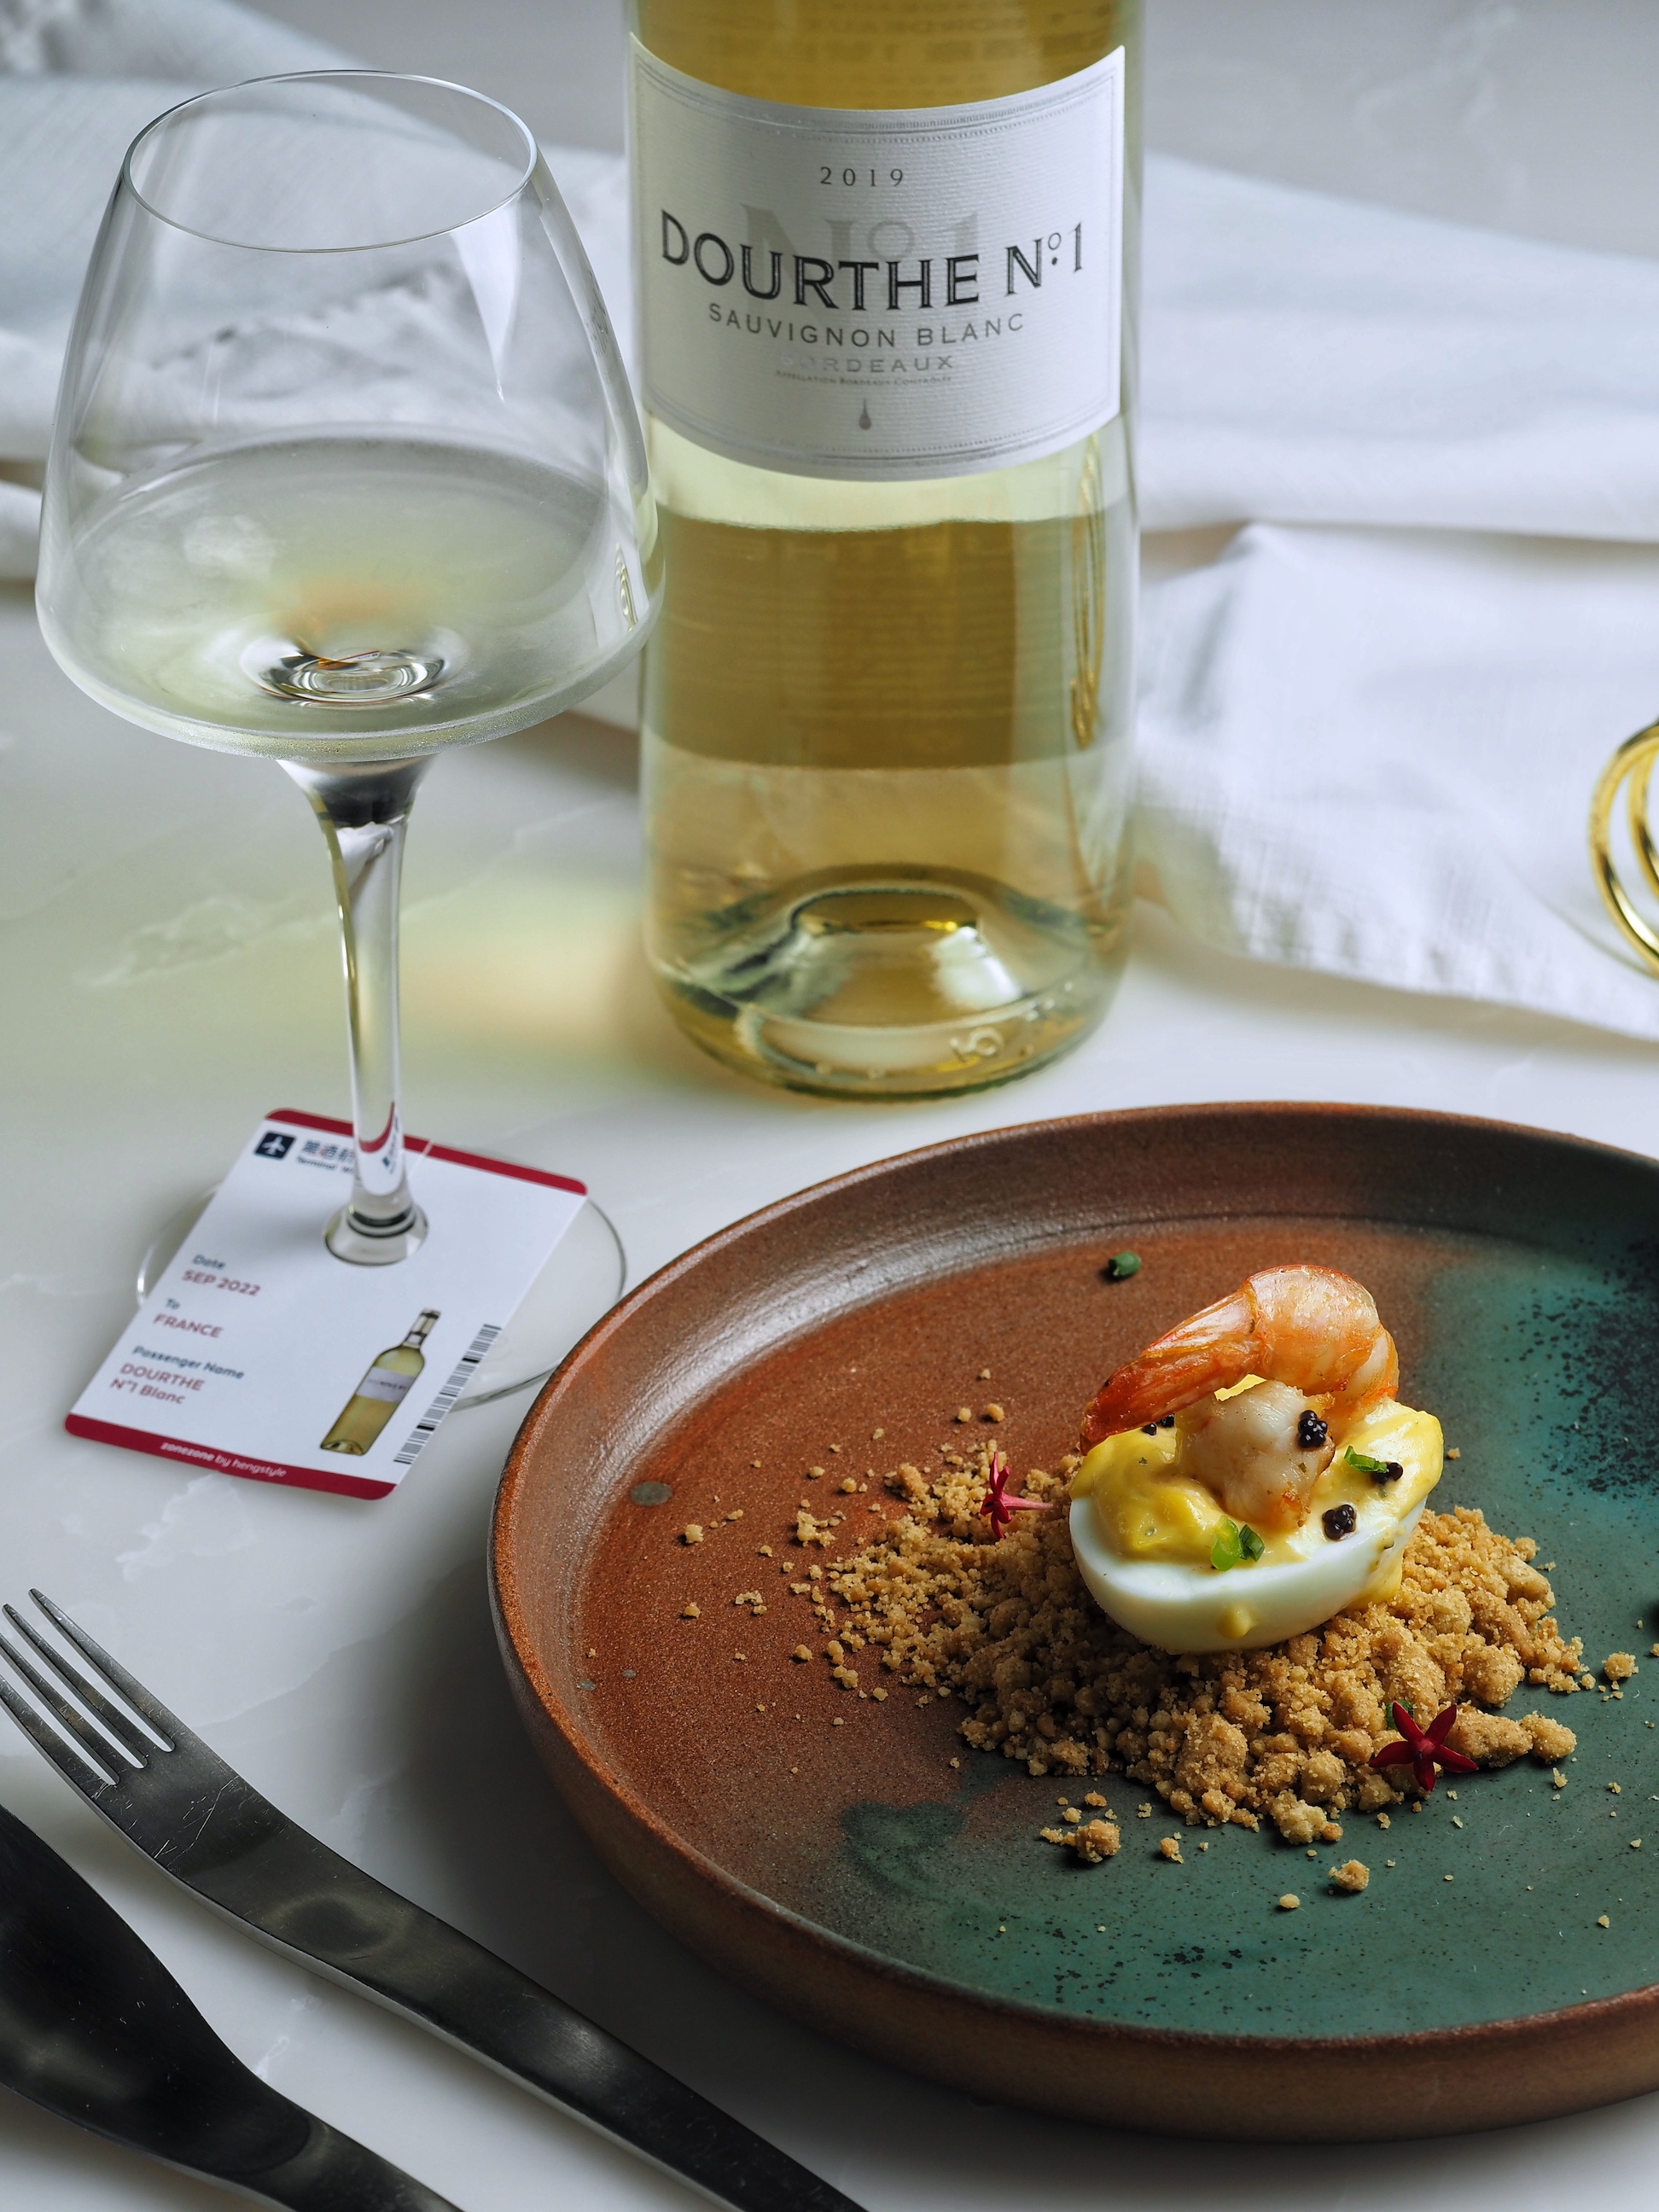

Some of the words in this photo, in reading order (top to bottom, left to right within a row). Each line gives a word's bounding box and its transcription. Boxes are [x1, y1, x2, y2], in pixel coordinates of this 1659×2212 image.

[820, 166, 903, 187] 2019
[661, 209, 981, 311] DOURTHE
[709, 303, 894, 347] SAUVIGNON
[917, 313, 1023, 346] BLANC
[192, 1254, 225, 1270] Date
[183, 1270, 217, 1284] SEP
[218, 1278, 261, 1296] 2022
[166, 1297, 180, 1310] To
[153, 1313, 224, 1338] FRANCE
[132, 1345, 201, 1368] Passenger
[203, 1363, 244, 1379] Name
[119, 1363, 205, 1391] DOURTHE
[139, 1385, 186, 1404] Blanc
[214, 1453, 232, 1467] by
[231, 1458, 287, 1476] hengstyle
